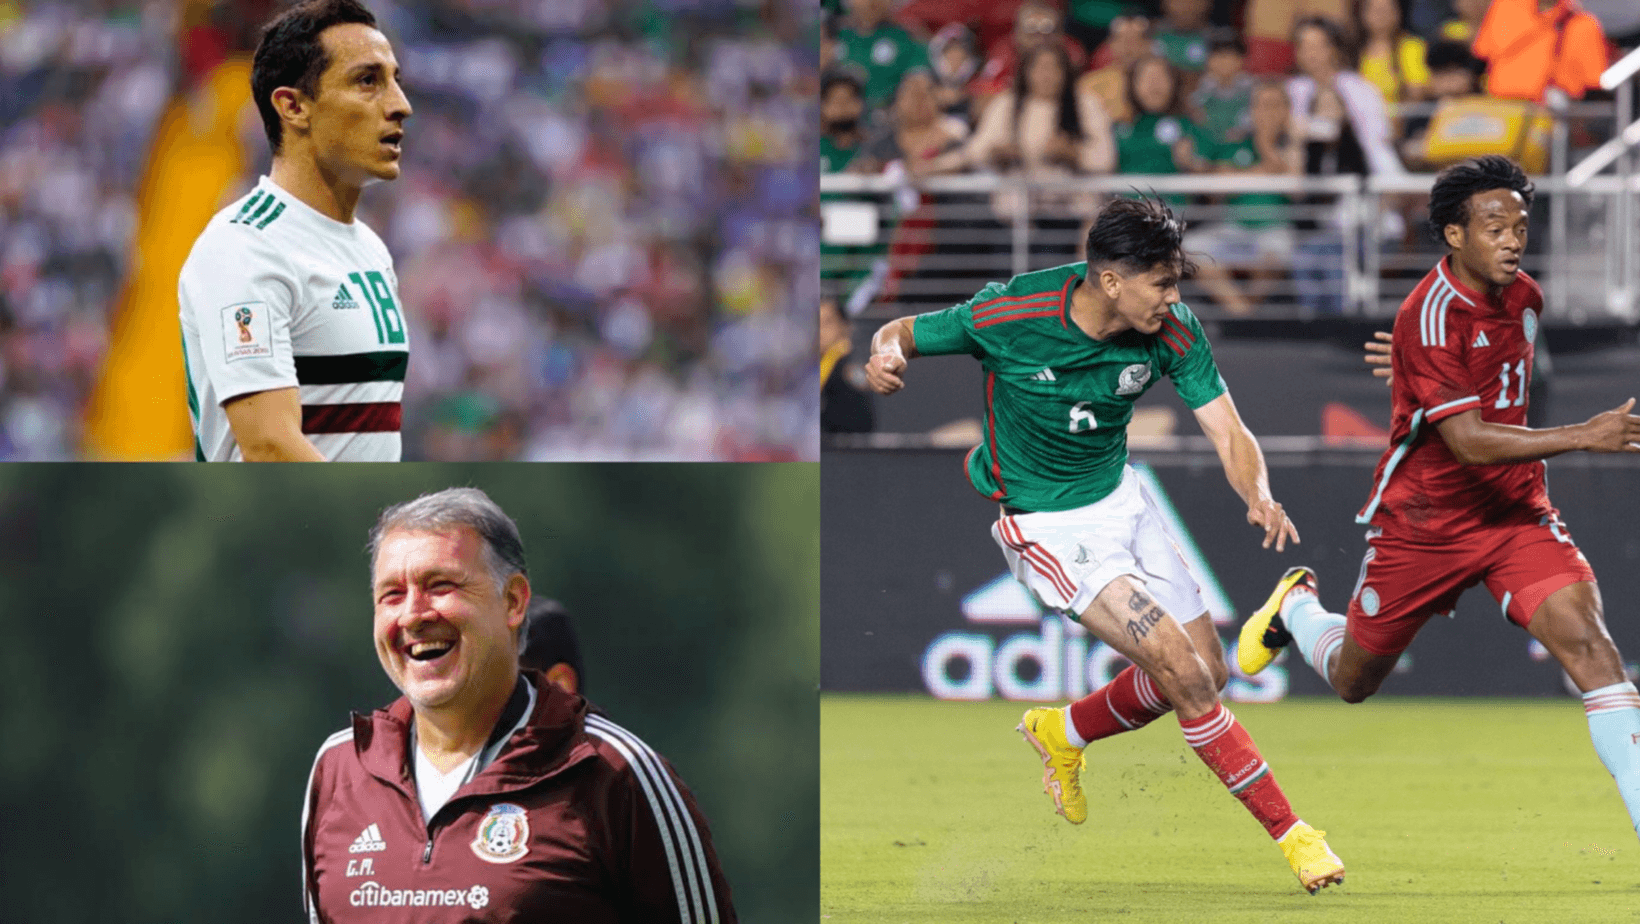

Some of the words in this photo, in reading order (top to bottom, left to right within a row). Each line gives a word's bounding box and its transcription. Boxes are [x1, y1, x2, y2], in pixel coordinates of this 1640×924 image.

[332, 300, 360, 310] adidas
[348, 271, 406, 344] 18
[1494, 359, 1526, 409] 11
[1069, 401, 1098, 433] 6
[921, 611, 1291, 702] adis
[348, 841, 387, 854] adidas
[350, 881, 468, 907] citibanamex
